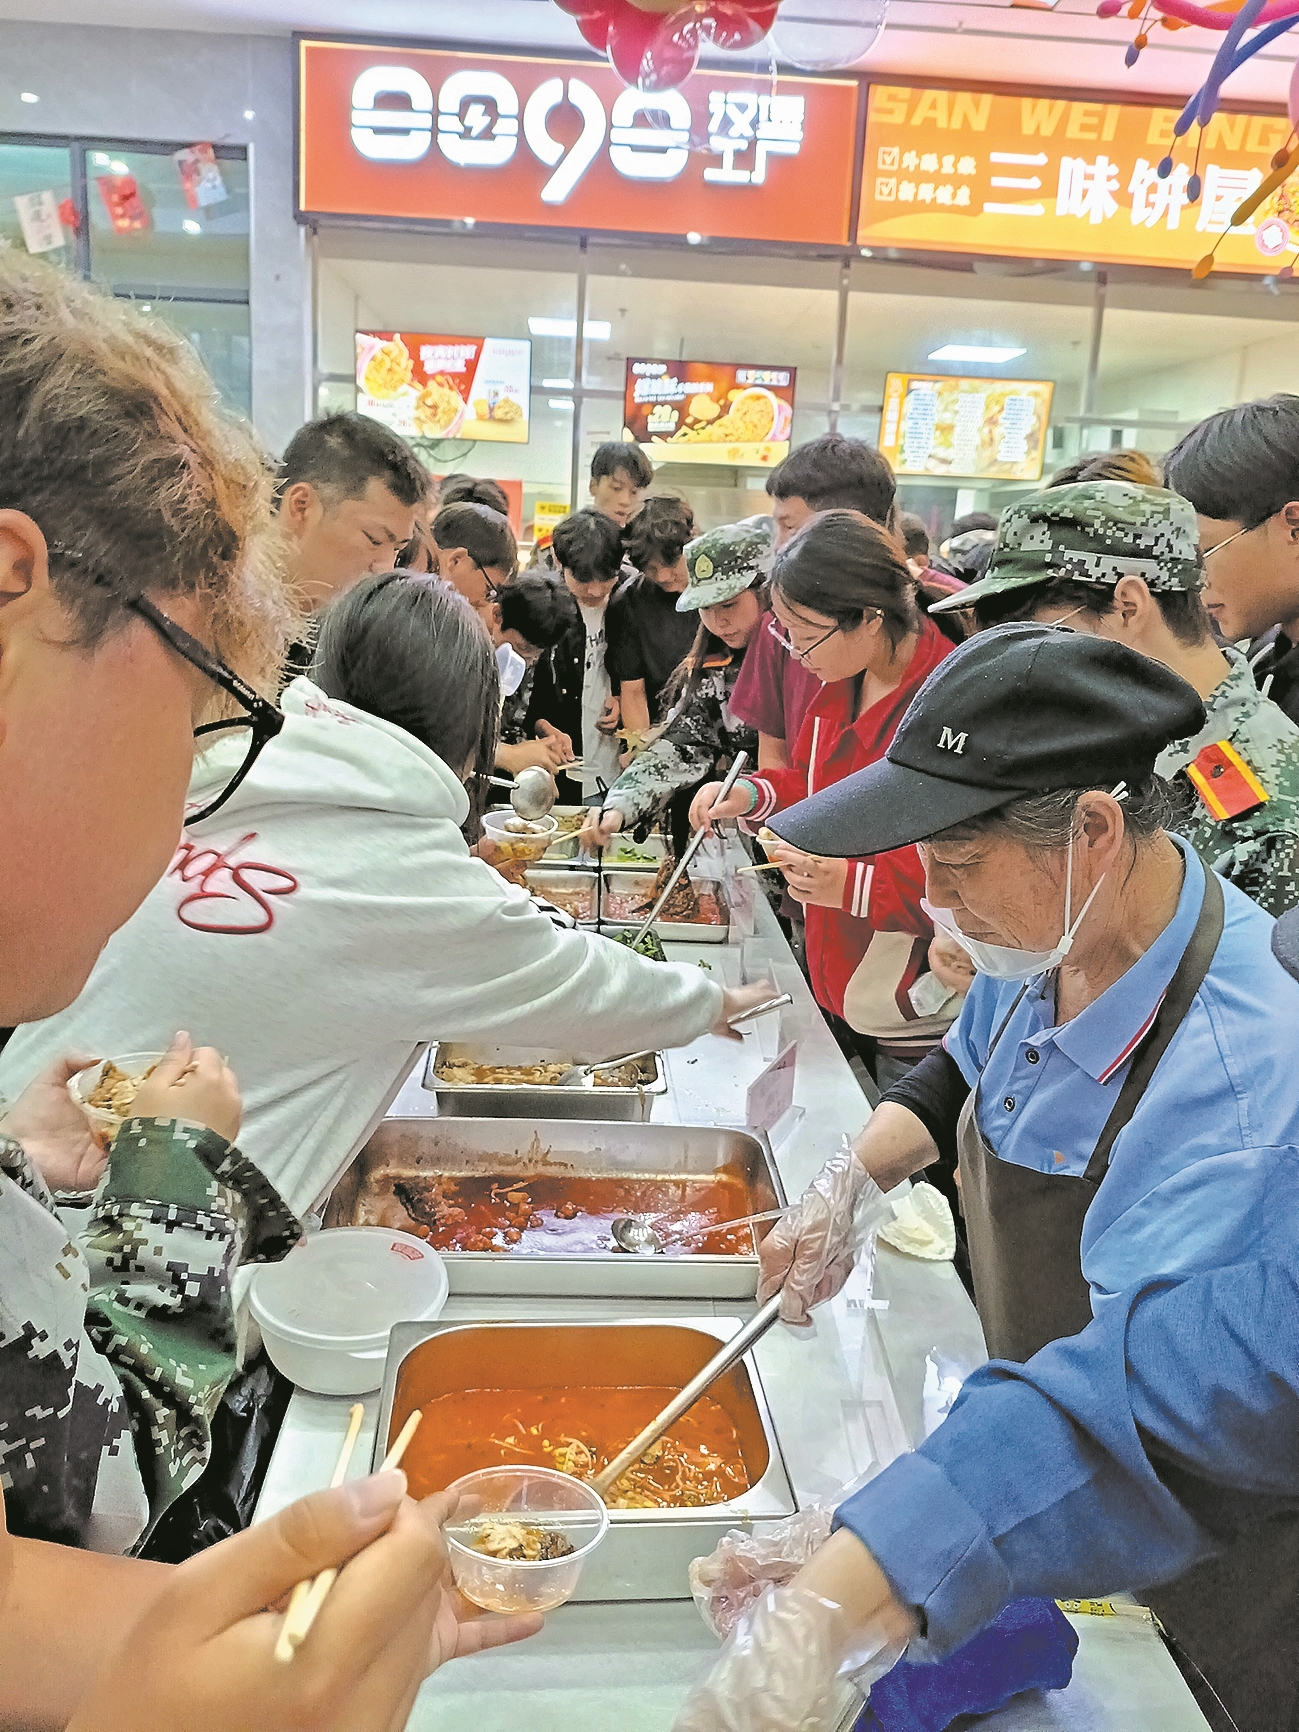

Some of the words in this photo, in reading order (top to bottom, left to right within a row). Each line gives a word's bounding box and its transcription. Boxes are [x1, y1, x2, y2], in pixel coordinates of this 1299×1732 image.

[870, 86, 993, 132] SAN
[1020, 97, 1122, 142] WEI
[983, 151, 1264, 236] 三味饼屋
[936, 726, 969, 754] M
